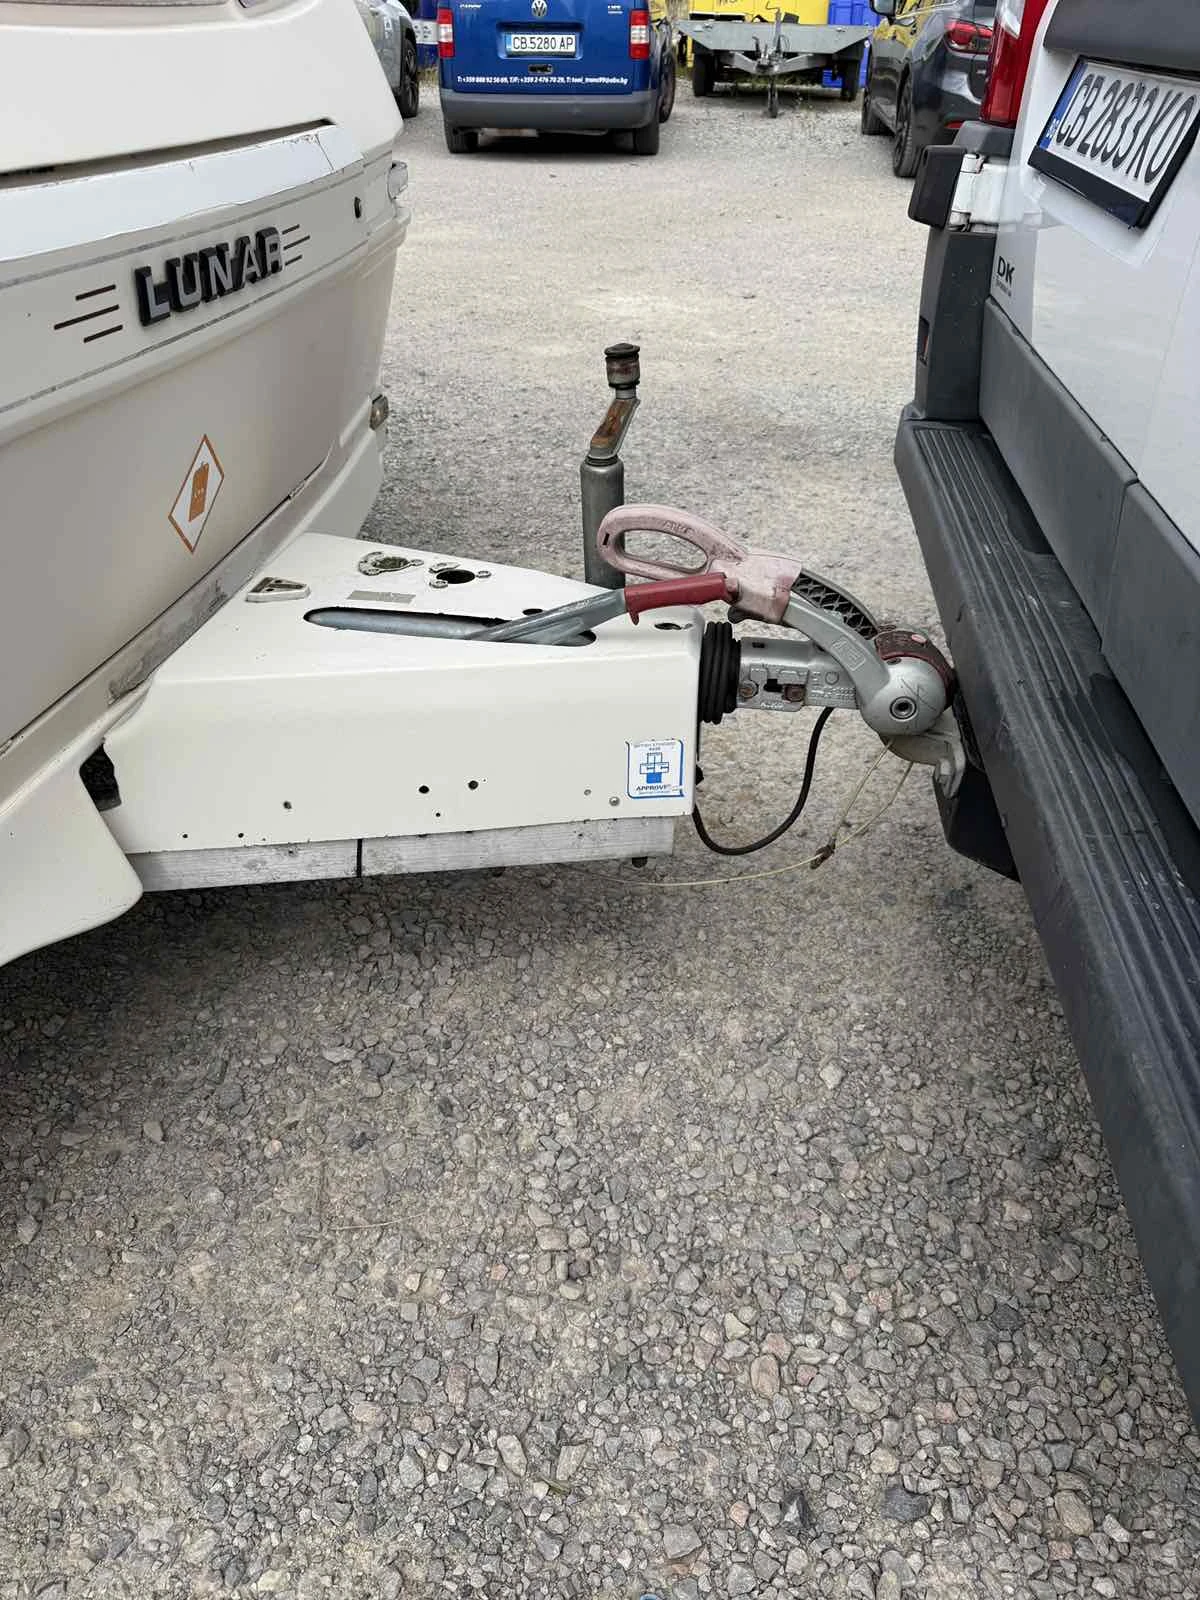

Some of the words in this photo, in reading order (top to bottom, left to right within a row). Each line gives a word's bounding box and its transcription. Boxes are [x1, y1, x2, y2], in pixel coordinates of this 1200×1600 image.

[513, 36, 527, 50] CB
[529, 36, 557, 50] 5280
[559, 36, 574, 50] AP
[1056, 73, 1105, 148] CB
[1077, 79, 1159, 168] 2833
[1126, 89, 1196, 184] KO
[134, 226, 283, 327] LUNAR
[996, 255, 1015, 288] DK
